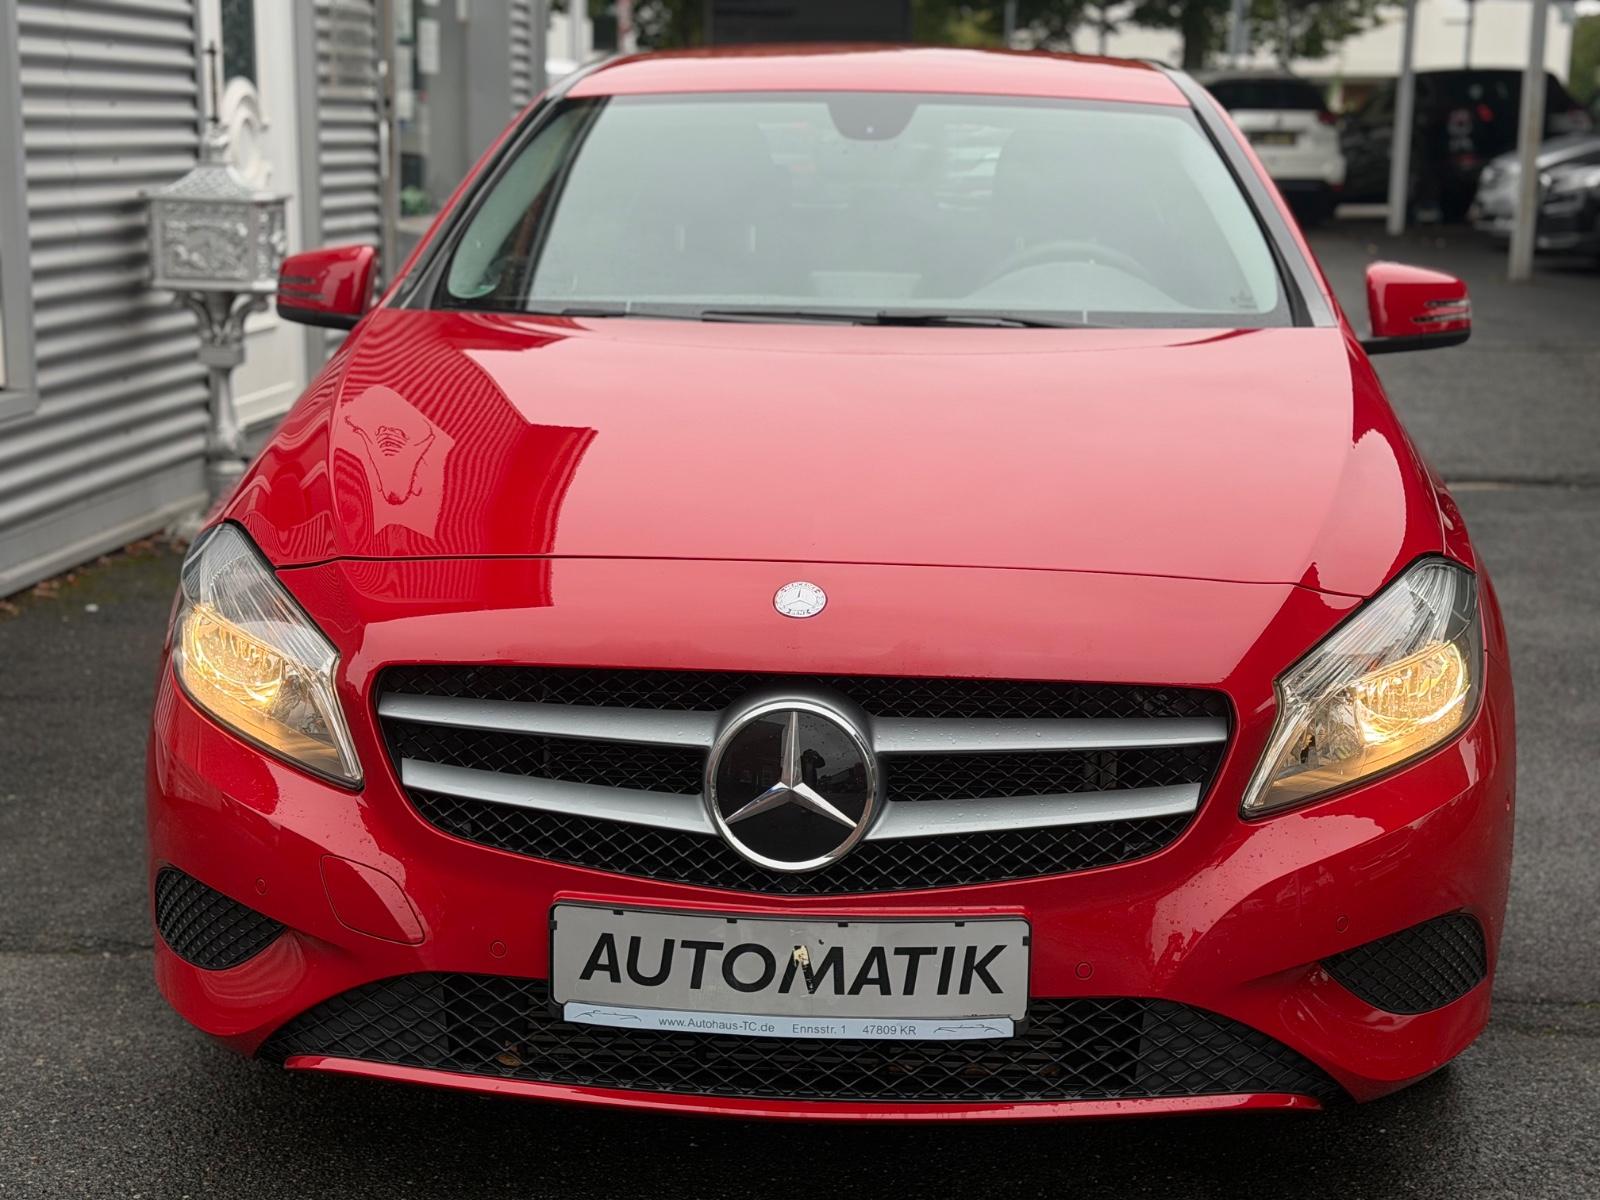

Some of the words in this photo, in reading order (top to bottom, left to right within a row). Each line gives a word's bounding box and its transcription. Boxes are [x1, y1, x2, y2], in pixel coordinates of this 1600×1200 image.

[579, 932, 1007, 996] AUTOMATIK
[658, 1017, 775, 1033] www.Autohaus-TC.de
[792, 1024, 837, 1035] Ennsstr.
[841, 1024, 846, 1035] 1
[862, 1026, 897, 1035] 47809
[900, 1026, 917, 1035] KR
